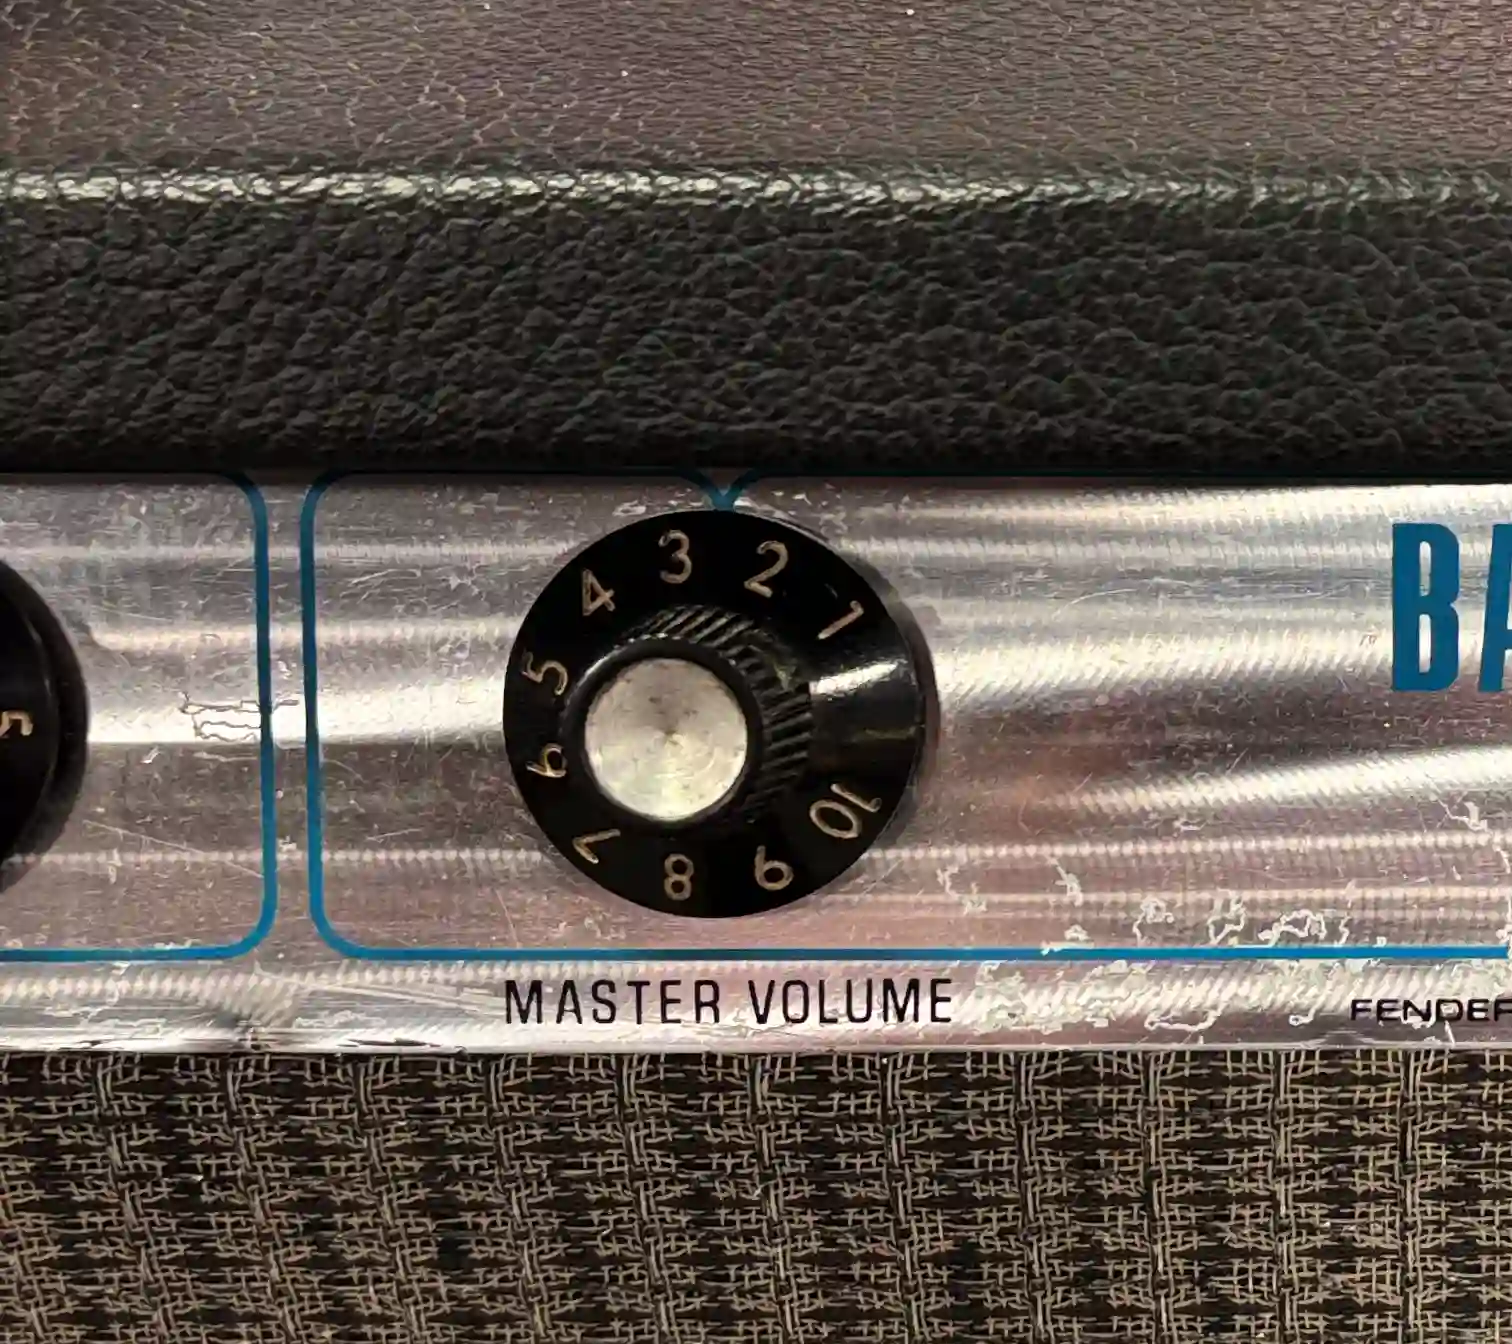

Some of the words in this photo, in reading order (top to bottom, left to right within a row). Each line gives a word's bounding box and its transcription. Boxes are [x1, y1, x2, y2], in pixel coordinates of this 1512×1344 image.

[658, 530, 693, 584] 3
[743, 540, 789, 598] 2
[581, 569, 616, 617] 4
[817, 600, 865, 640] 1
[521, 651, 569, 696] 5
[526, 743, 568, 778] 6
[808, 782, 883, 840] 10
[572, 829, 621, 864] 7
[753, 845, 795, 891] 9
[663, 853, 695, 901] 8
[504, 978, 720, 1025] MASTER
[747, 977, 953, 1025] VOLUME
